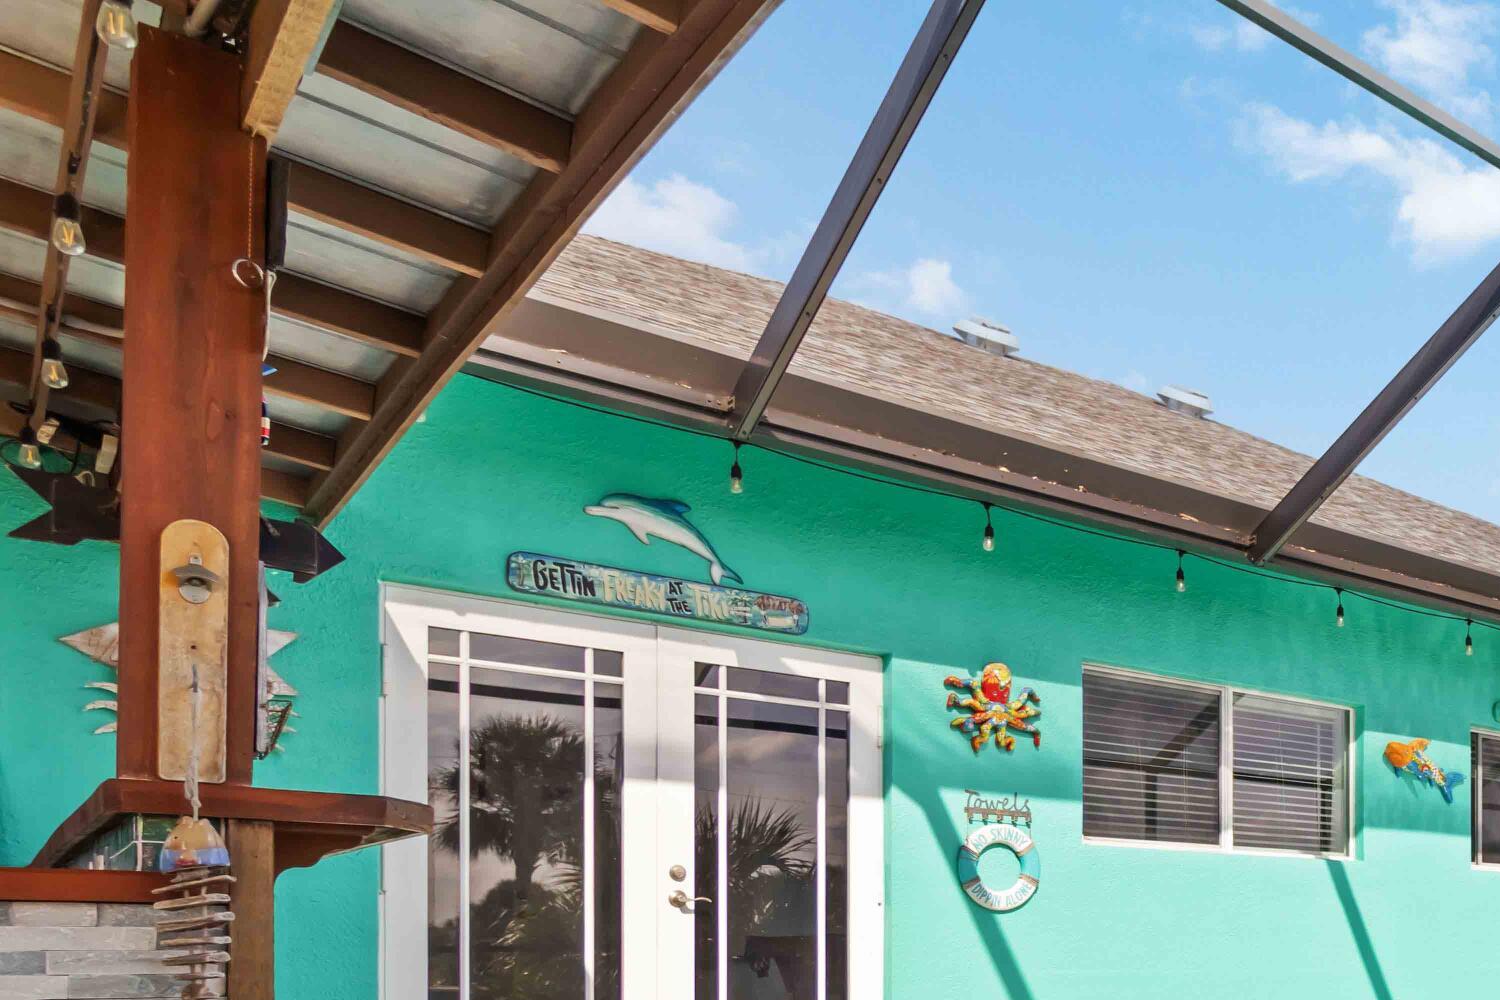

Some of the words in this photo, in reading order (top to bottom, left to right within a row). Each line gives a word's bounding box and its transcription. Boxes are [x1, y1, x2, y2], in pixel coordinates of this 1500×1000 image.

[603, 570, 666, 611] FREAKY
[668, 581, 683, 596] AT
[666, 597, 692, 615] THE
[964, 789, 1031, 812] Towels
[971, 834, 988, 853] NO
[990, 828, 1027, 847] SKINNY
[1005, 884, 1032, 906] ALONE
